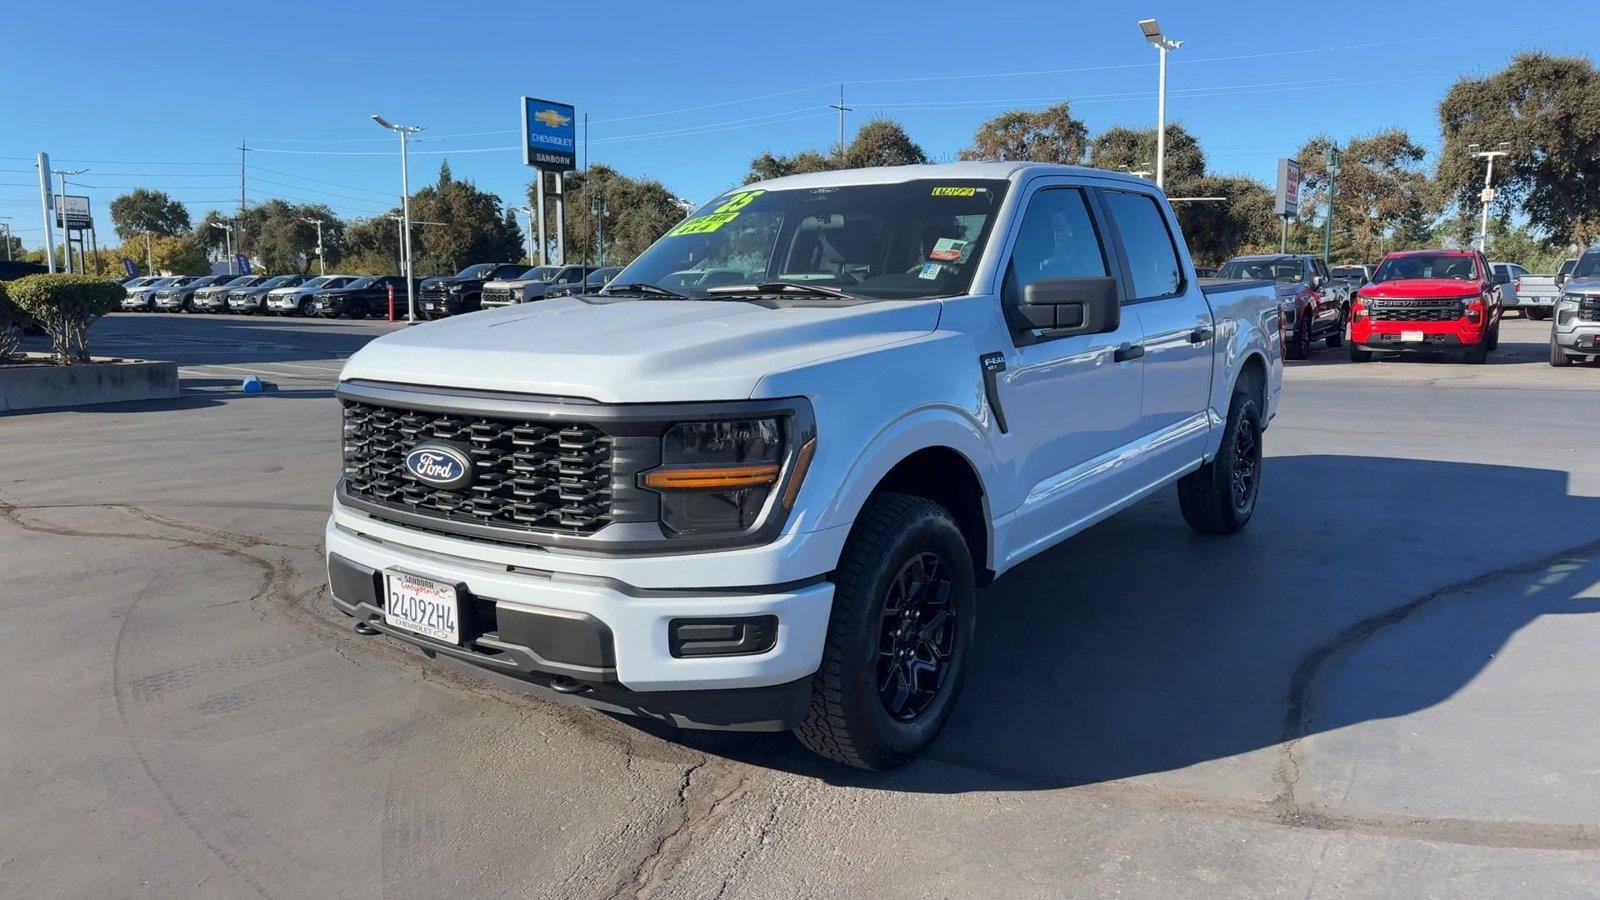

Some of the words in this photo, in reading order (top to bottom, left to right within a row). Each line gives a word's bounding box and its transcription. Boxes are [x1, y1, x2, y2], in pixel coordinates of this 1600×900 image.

[531, 133, 573, 147] CHEVROLET
[536, 153, 570, 165] SANBORN
[417, 453, 452, 478] Ford
[404, 575, 434, 589] SANBORN
[392, 591, 455, 633] 24092H4
